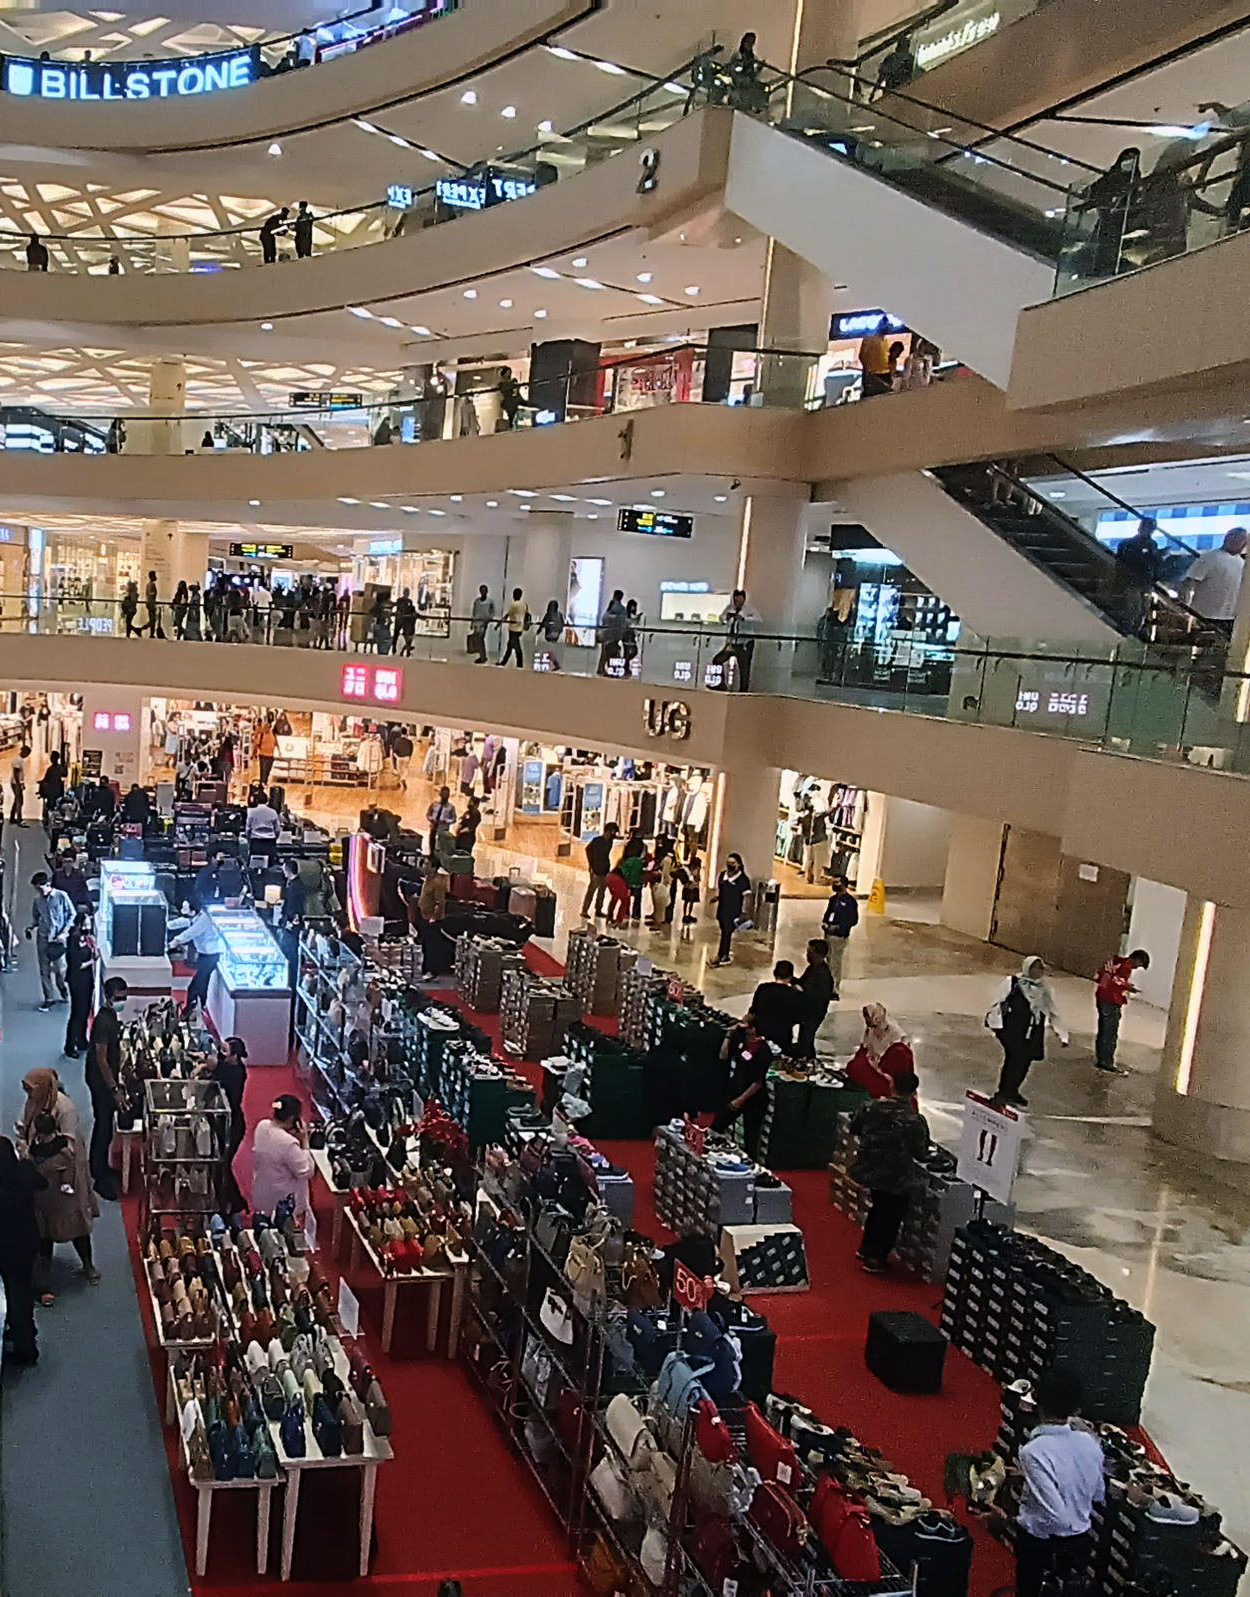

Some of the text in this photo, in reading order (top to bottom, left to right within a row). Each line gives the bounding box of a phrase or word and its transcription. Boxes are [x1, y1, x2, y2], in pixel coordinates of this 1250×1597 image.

[41, 54, 252, 100] BILLSTONE
[636, 147, 660, 194] 2
[643, 698, 691, 739] UG
